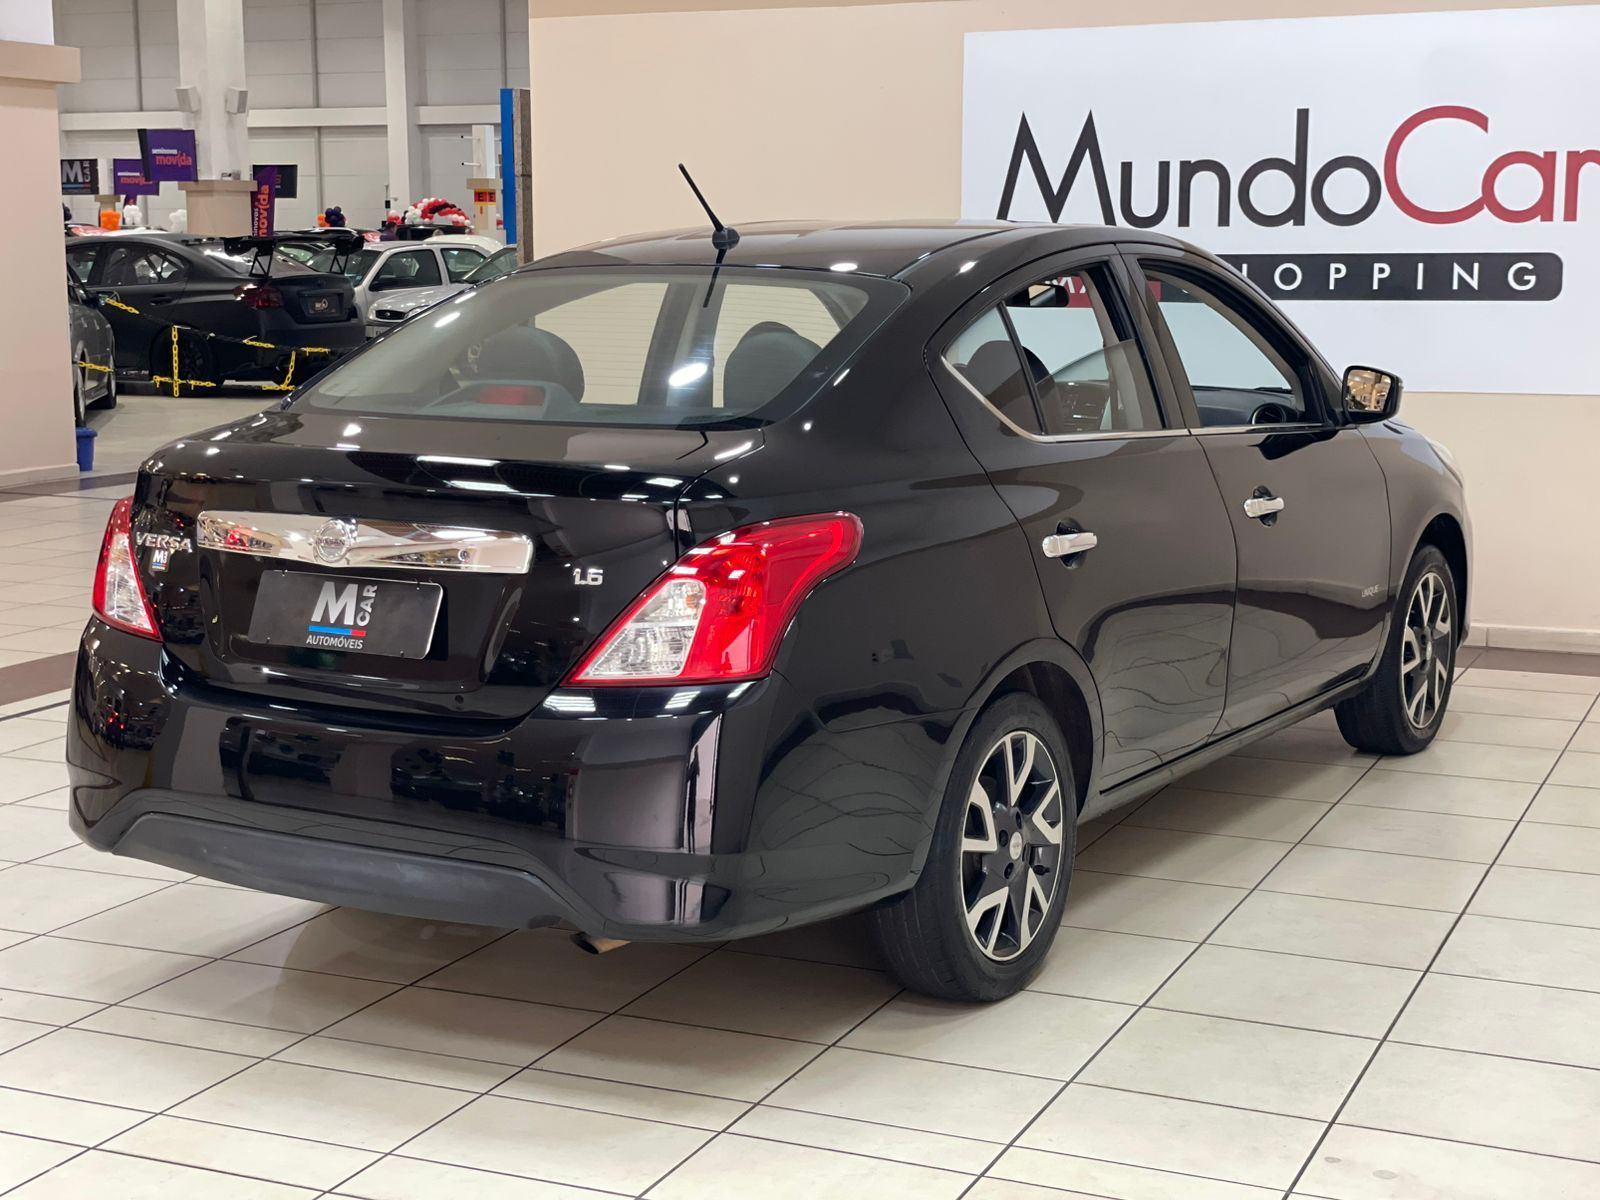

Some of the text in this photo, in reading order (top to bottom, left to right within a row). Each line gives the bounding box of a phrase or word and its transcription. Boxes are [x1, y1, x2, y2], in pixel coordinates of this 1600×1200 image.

[155, 152, 193, 167] movida
[996, 105, 1600, 229] MundoCar
[1241, 262, 1536, 290] OPPING
[136, 532, 192, 553] VERSA
[573, 568, 604, 586] 1.6
[311, 581, 378, 627] M CAR
[306, 635, 364, 650] AUTOMÓVEIS
